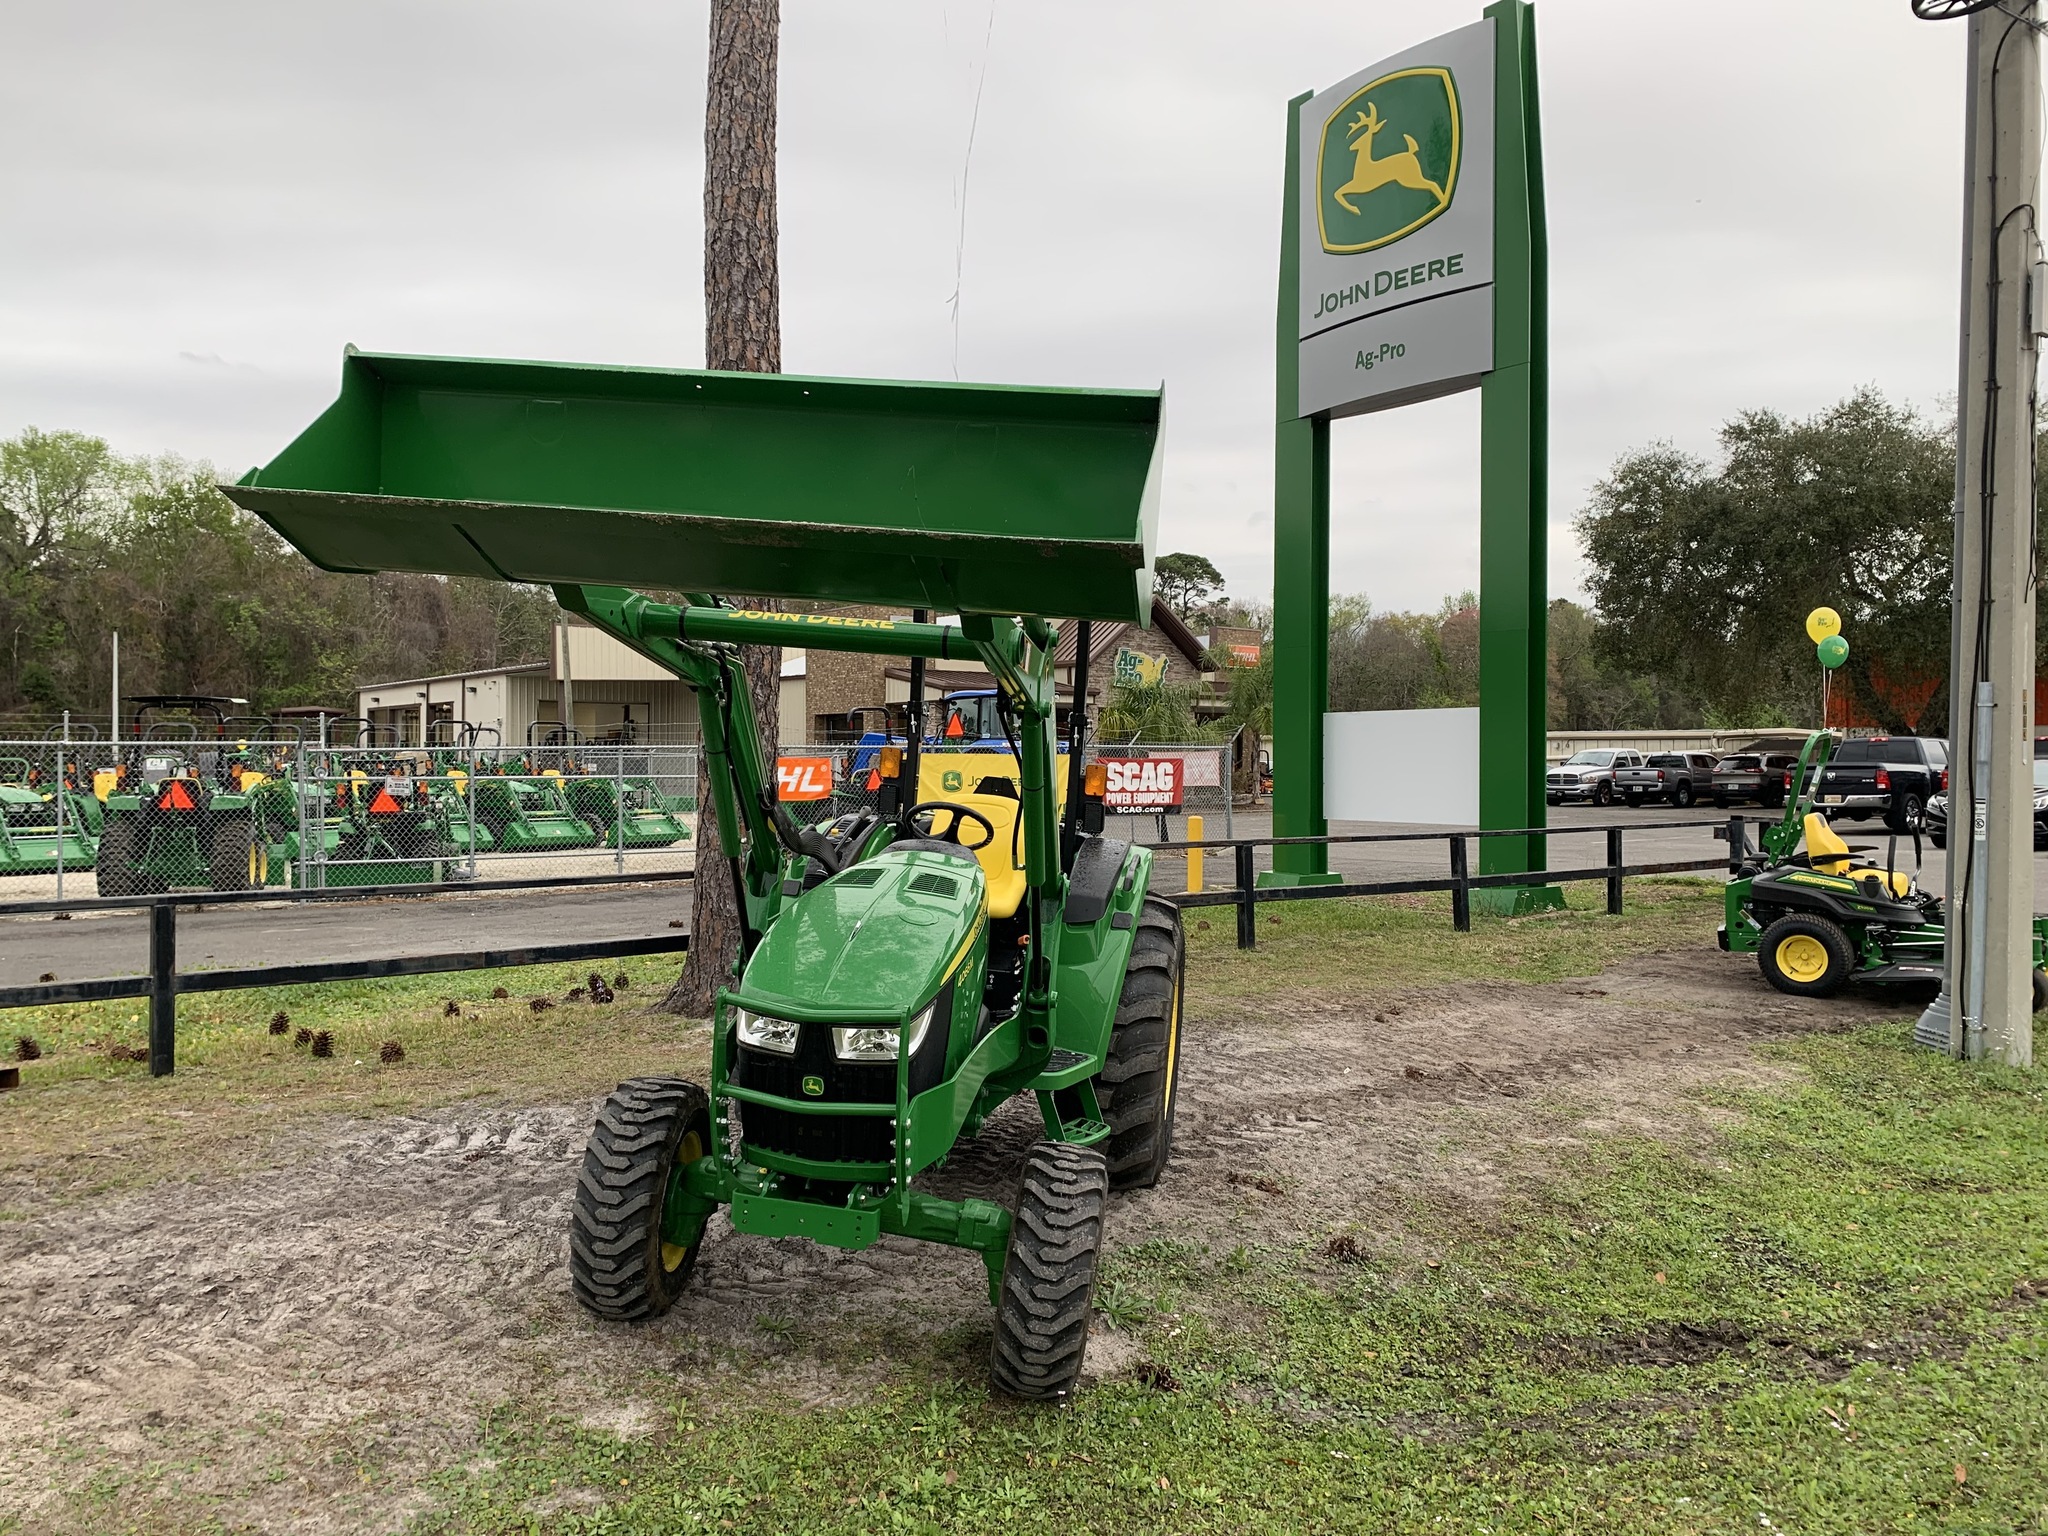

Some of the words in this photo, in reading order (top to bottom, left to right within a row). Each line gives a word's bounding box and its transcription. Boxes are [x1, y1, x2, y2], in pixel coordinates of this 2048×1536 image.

[1314, 280, 1370, 319] JOHN
[1374, 253, 1464, 297] DEERE
[1354, 343, 1406, 370] Ag-Pro
[728, 609, 799, 623] JOHN
[806, 615, 895, 630] DEERE
[1117, 650, 1143, 672] Ag-
[1106, 761, 1174, 792] SCAG
[1106, 792, 1132, 804] POWER
[1133, 792, 1175, 804] EQUIPMENT
[1116, 806, 1164, 814] SCAG.com
